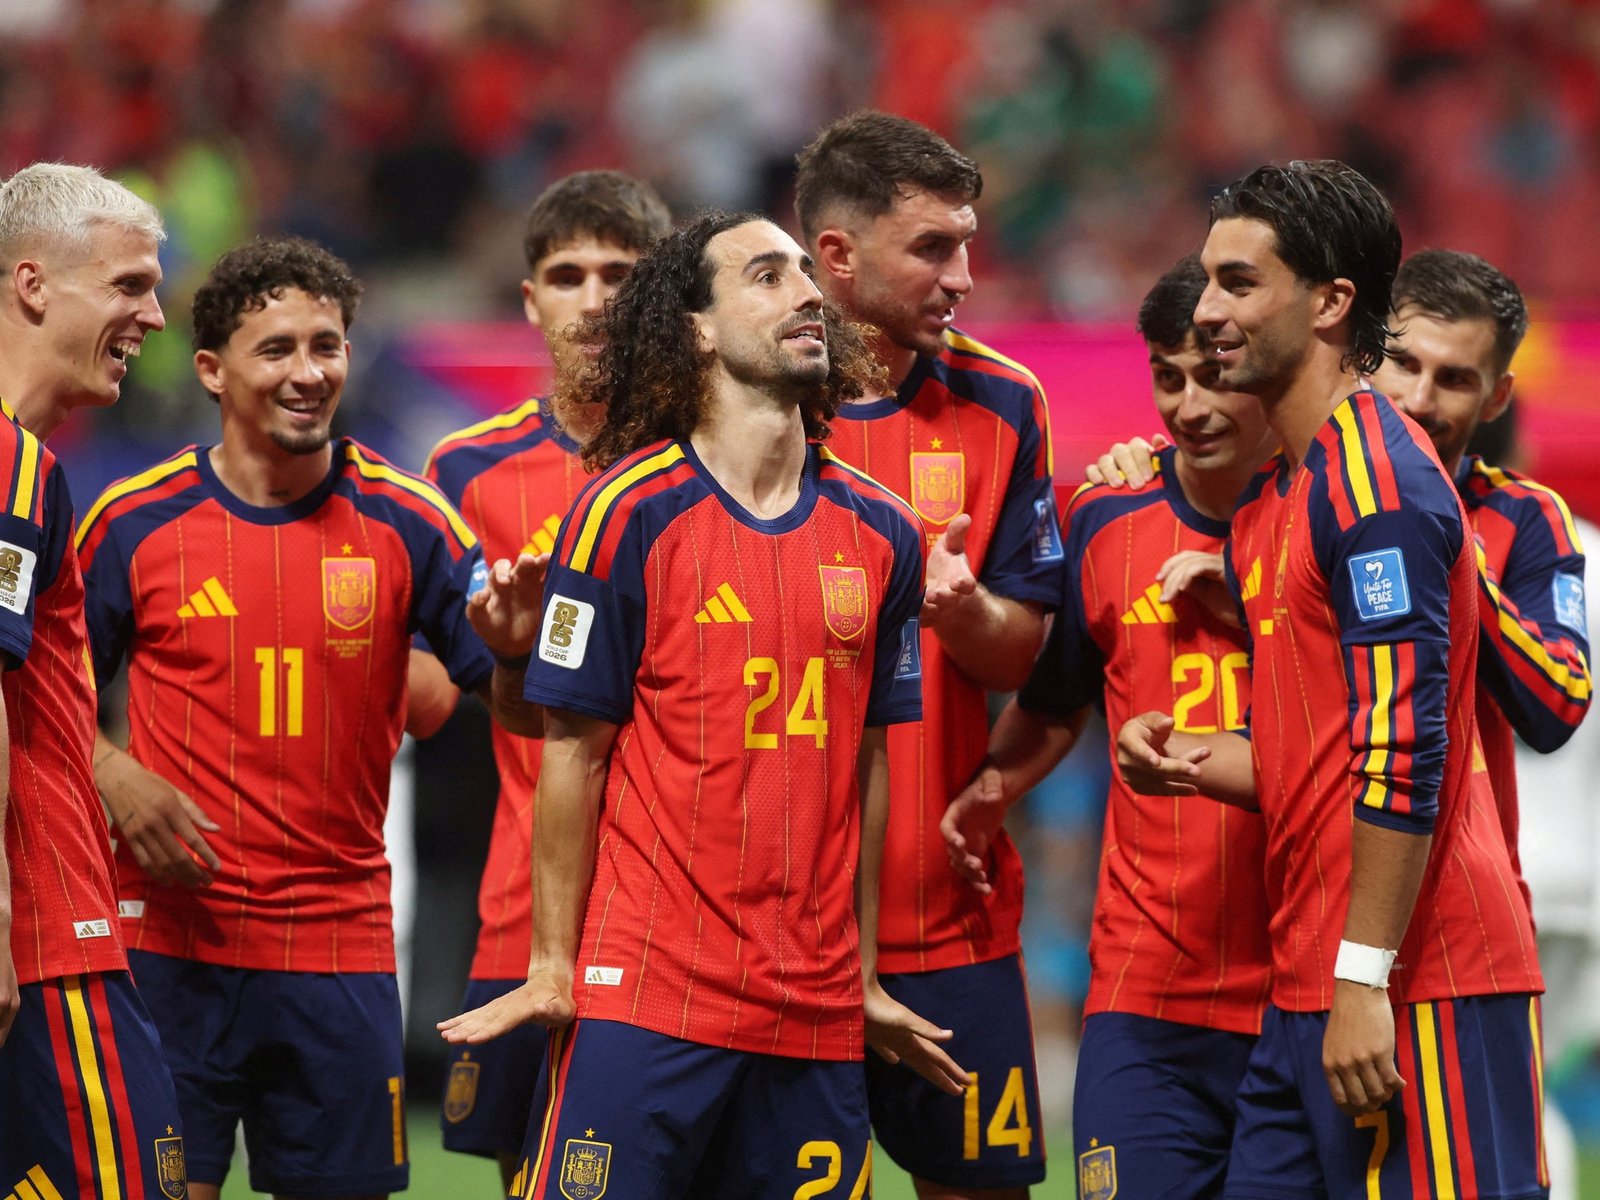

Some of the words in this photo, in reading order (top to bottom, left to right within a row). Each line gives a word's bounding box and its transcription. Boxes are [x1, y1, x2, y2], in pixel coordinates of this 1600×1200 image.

[1363, 581, 1381, 594] Unite
[1381, 578, 1393, 590] For
[0, 594, 15, 607] 026
[1367, 590, 1393, 606] PEACE
[1374, 604, 1389, 612] FIFA
[544, 649, 567, 661] 2026
[255, 648, 303, 737] 11
[744, 656, 828, 750] 24
[961, 1066, 1033, 1160] 14
[1354, 1110, 1390, 1200] 7
